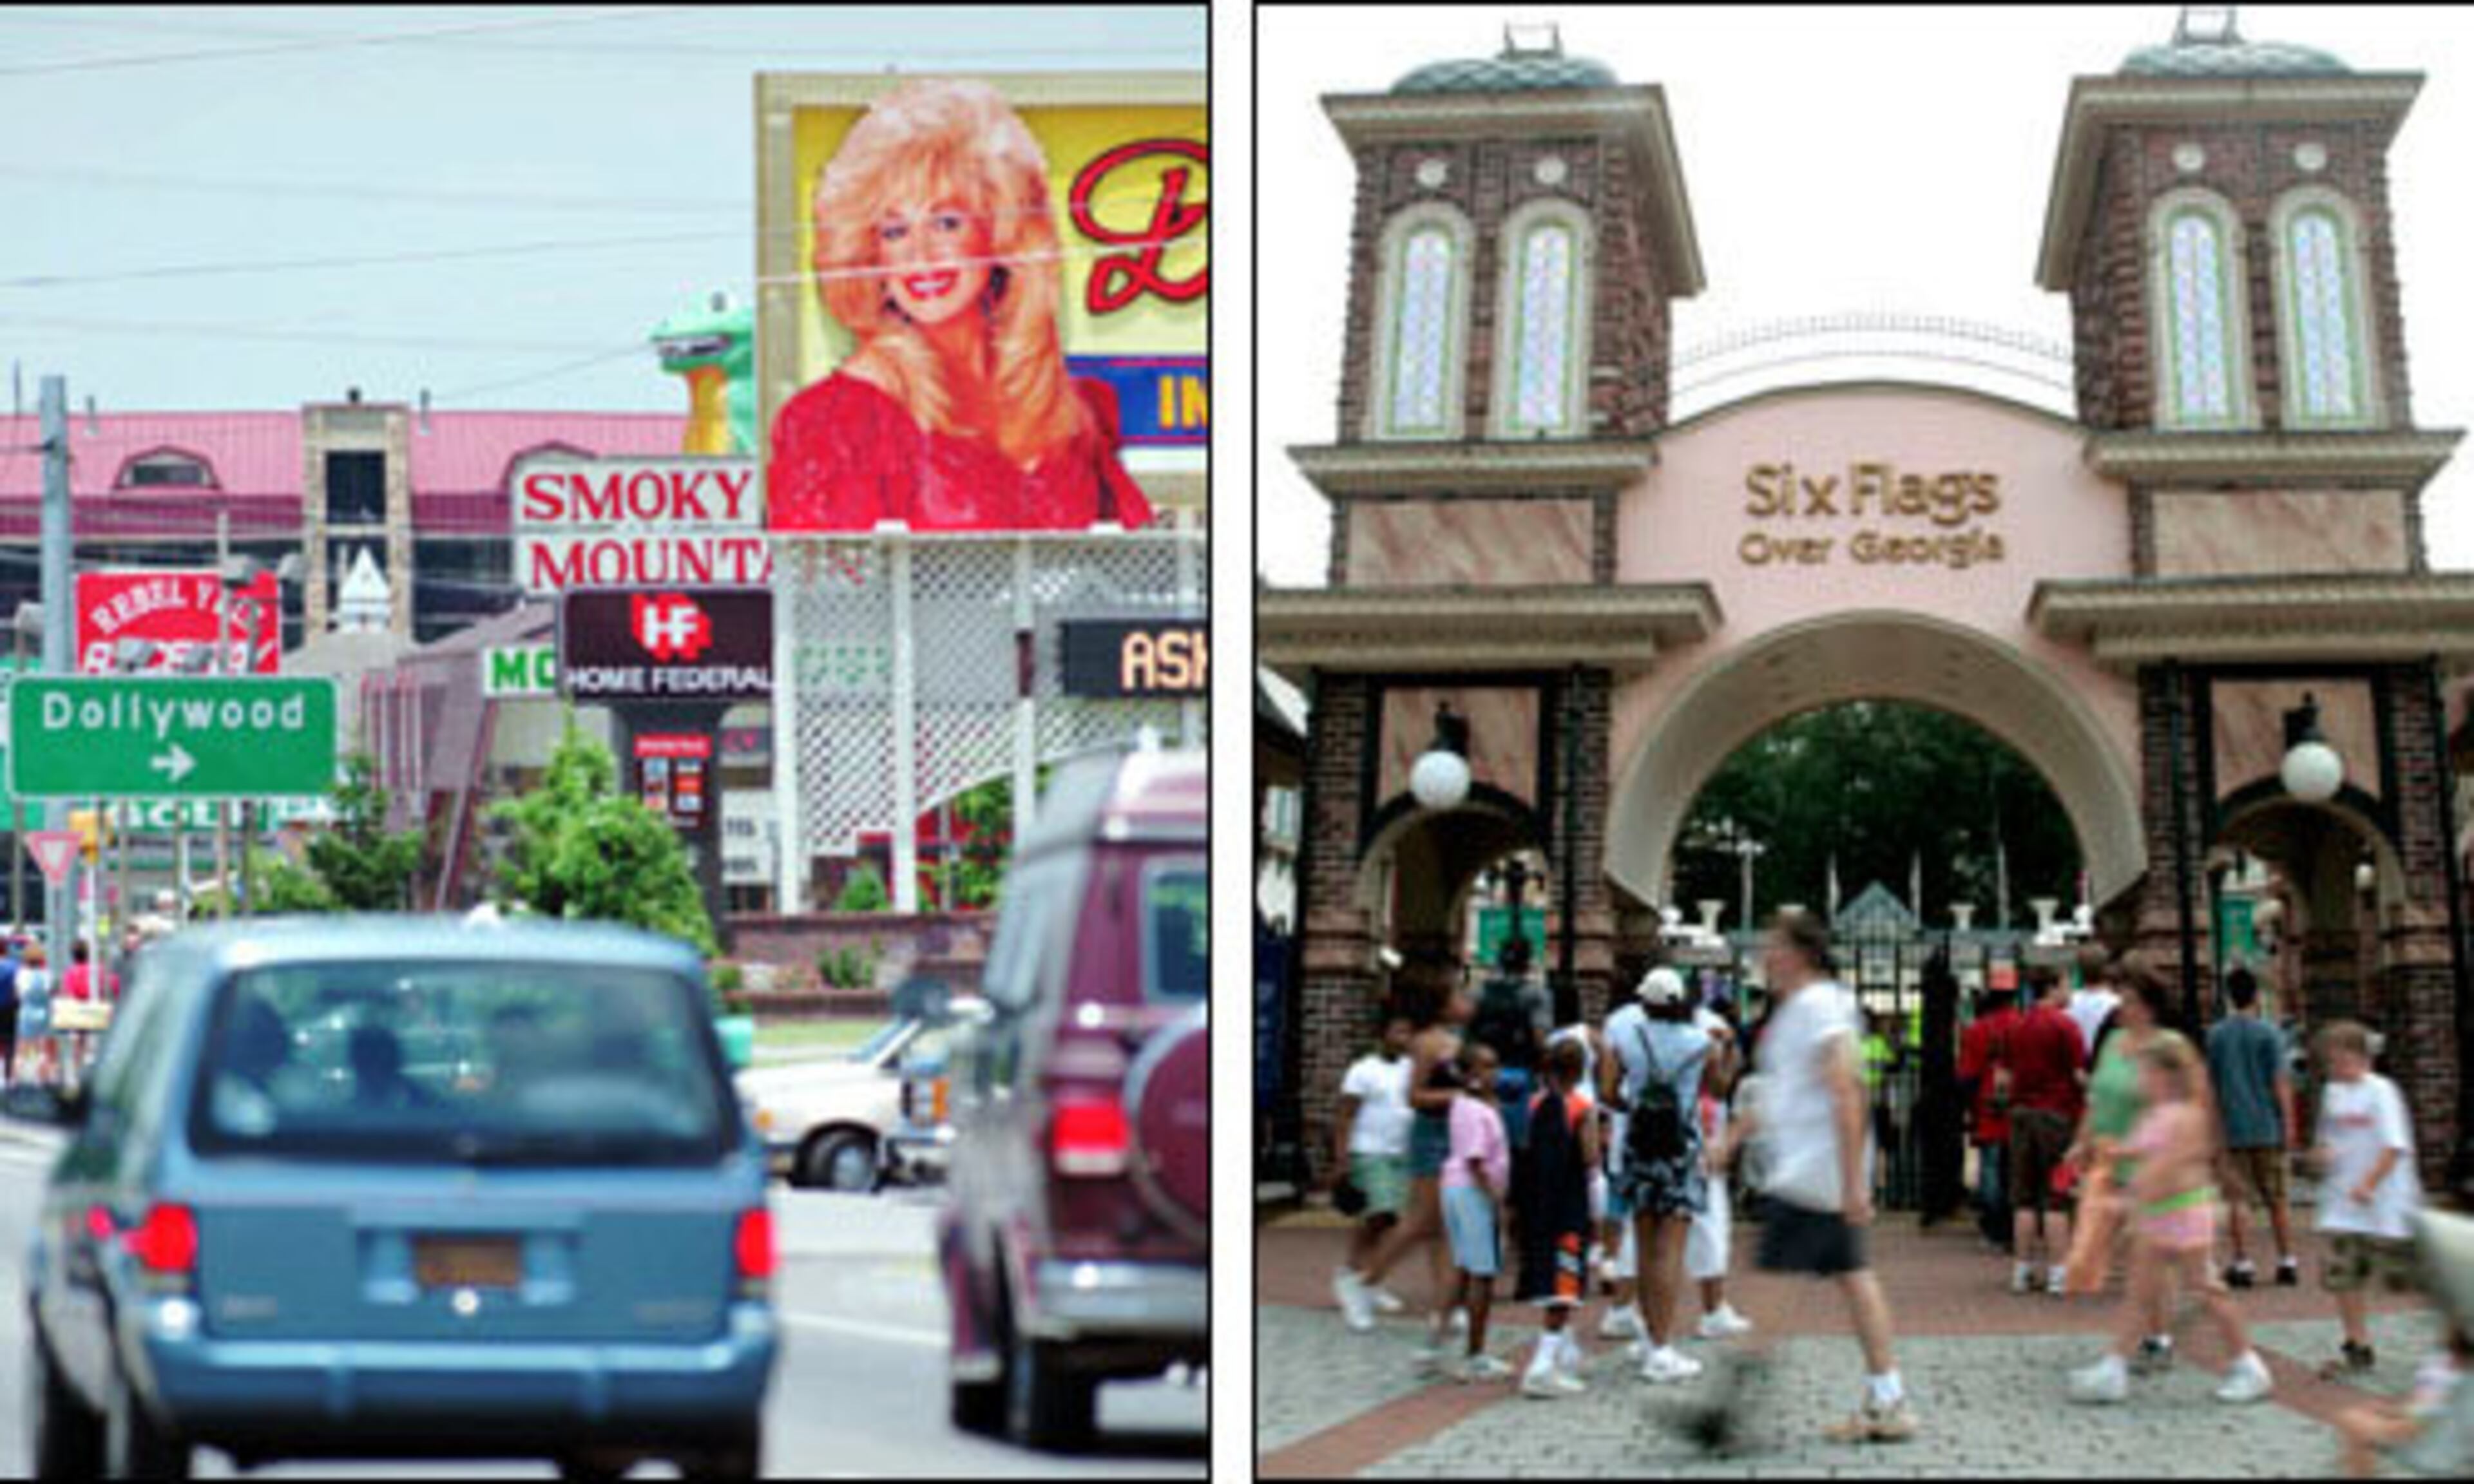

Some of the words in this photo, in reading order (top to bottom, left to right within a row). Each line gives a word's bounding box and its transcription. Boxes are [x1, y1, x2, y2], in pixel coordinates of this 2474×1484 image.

[523, 469, 753, 520] SMOKY
[1745, 462, 1839, 517] Six
[1848, 462, 2001, 528] Flags
[1738, 532, 1834, 566] Over
[1850, 527, 2003, 569] Georgia
[90, 576, 187, 633] REBEL
[644, 605, 697, 647] HF
[562, 667, 644, 693] HOME
[652, 666, 775, 693] FEDERAL
[43, 691, 304, 739] Dollywood
